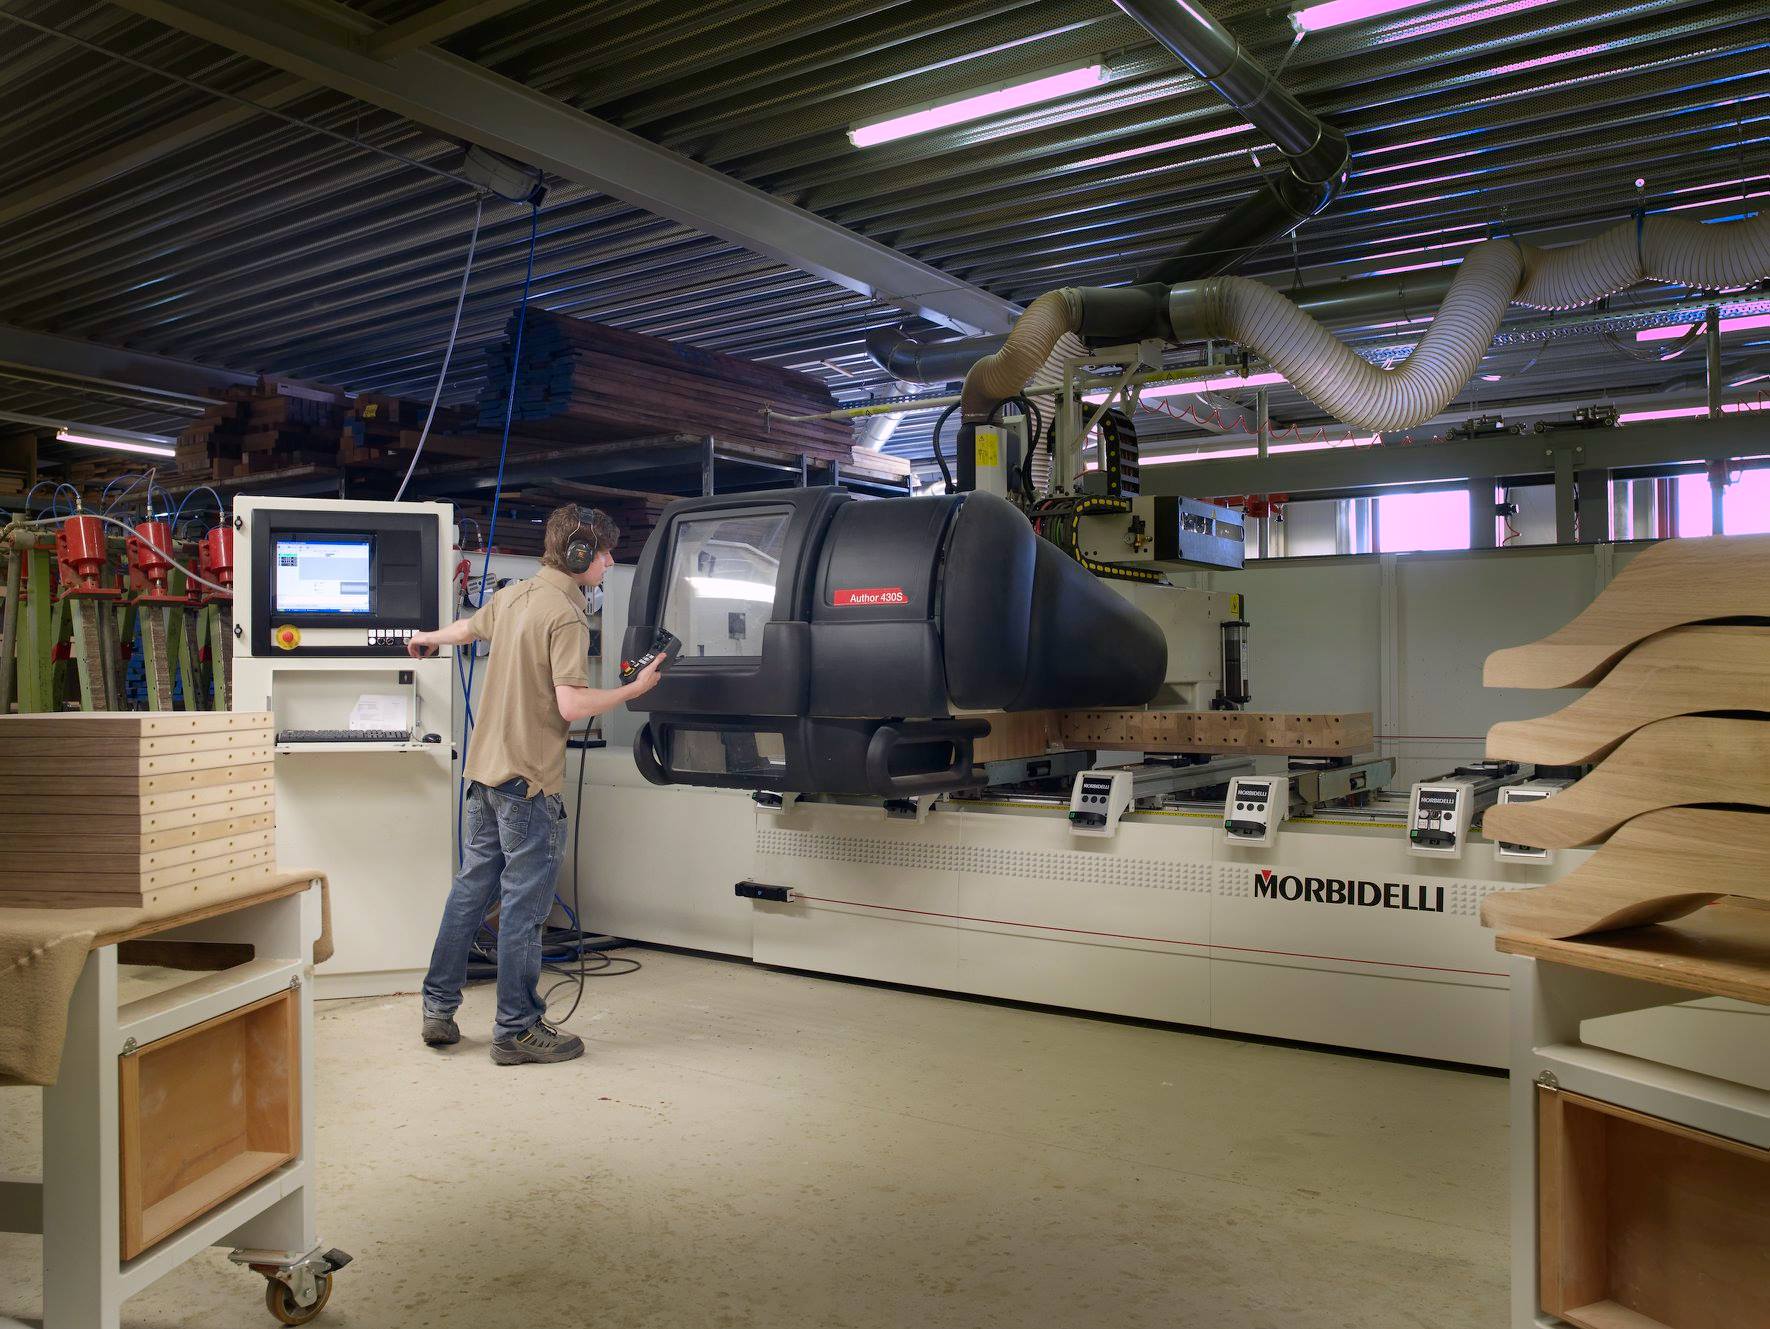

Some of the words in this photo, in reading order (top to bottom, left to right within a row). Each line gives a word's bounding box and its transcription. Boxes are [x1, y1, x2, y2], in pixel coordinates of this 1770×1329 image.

[850, 593, 879, 603] Author
[880, 592, 903, 602] 430S
[1254, 871, 1444, 913] MORBIDELLI
